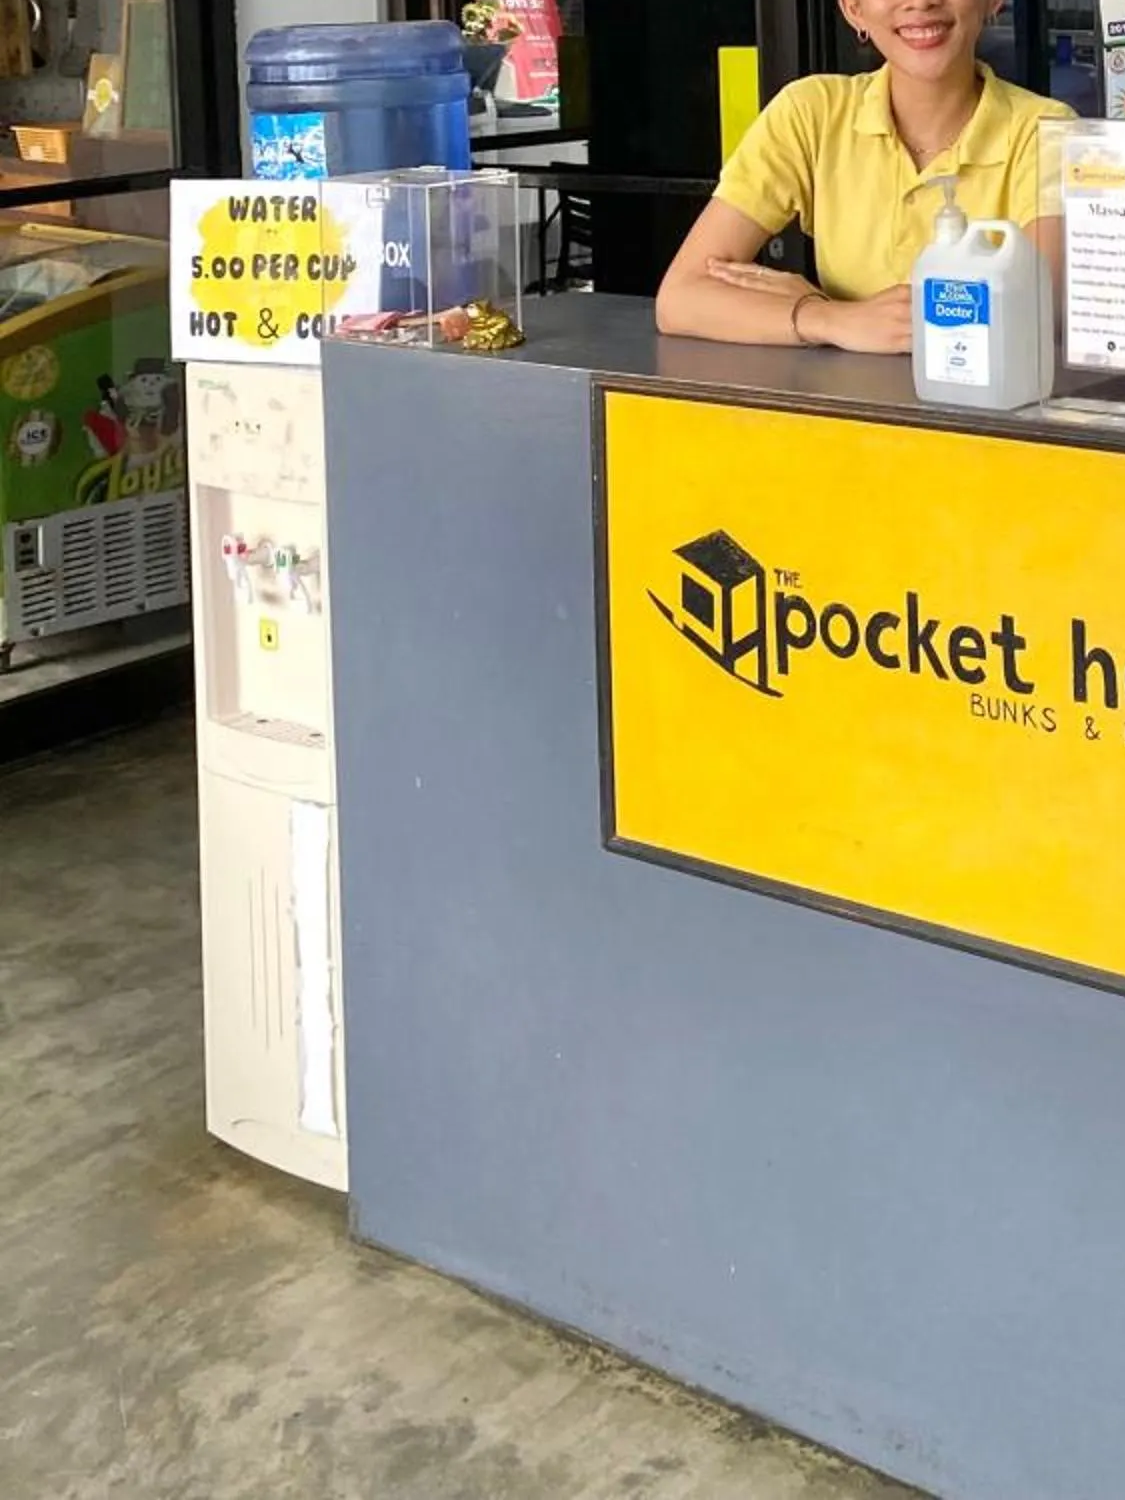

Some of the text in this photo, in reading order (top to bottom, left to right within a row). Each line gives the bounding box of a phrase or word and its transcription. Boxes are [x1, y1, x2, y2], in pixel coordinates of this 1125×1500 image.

[228, 195, 317, 223] WATER
[191, 253, 357, 281] 5.00 PER CUP
[190, 307, 351, 339] HOT & COL
[935, 303, 973, 319] Doctor
[773, 568, 802, 588] THE
[774, 591, 1035, 695] pocket
[970, 693, 1057, 733] BUNKS
[1085, 716, 1101, 741] &
